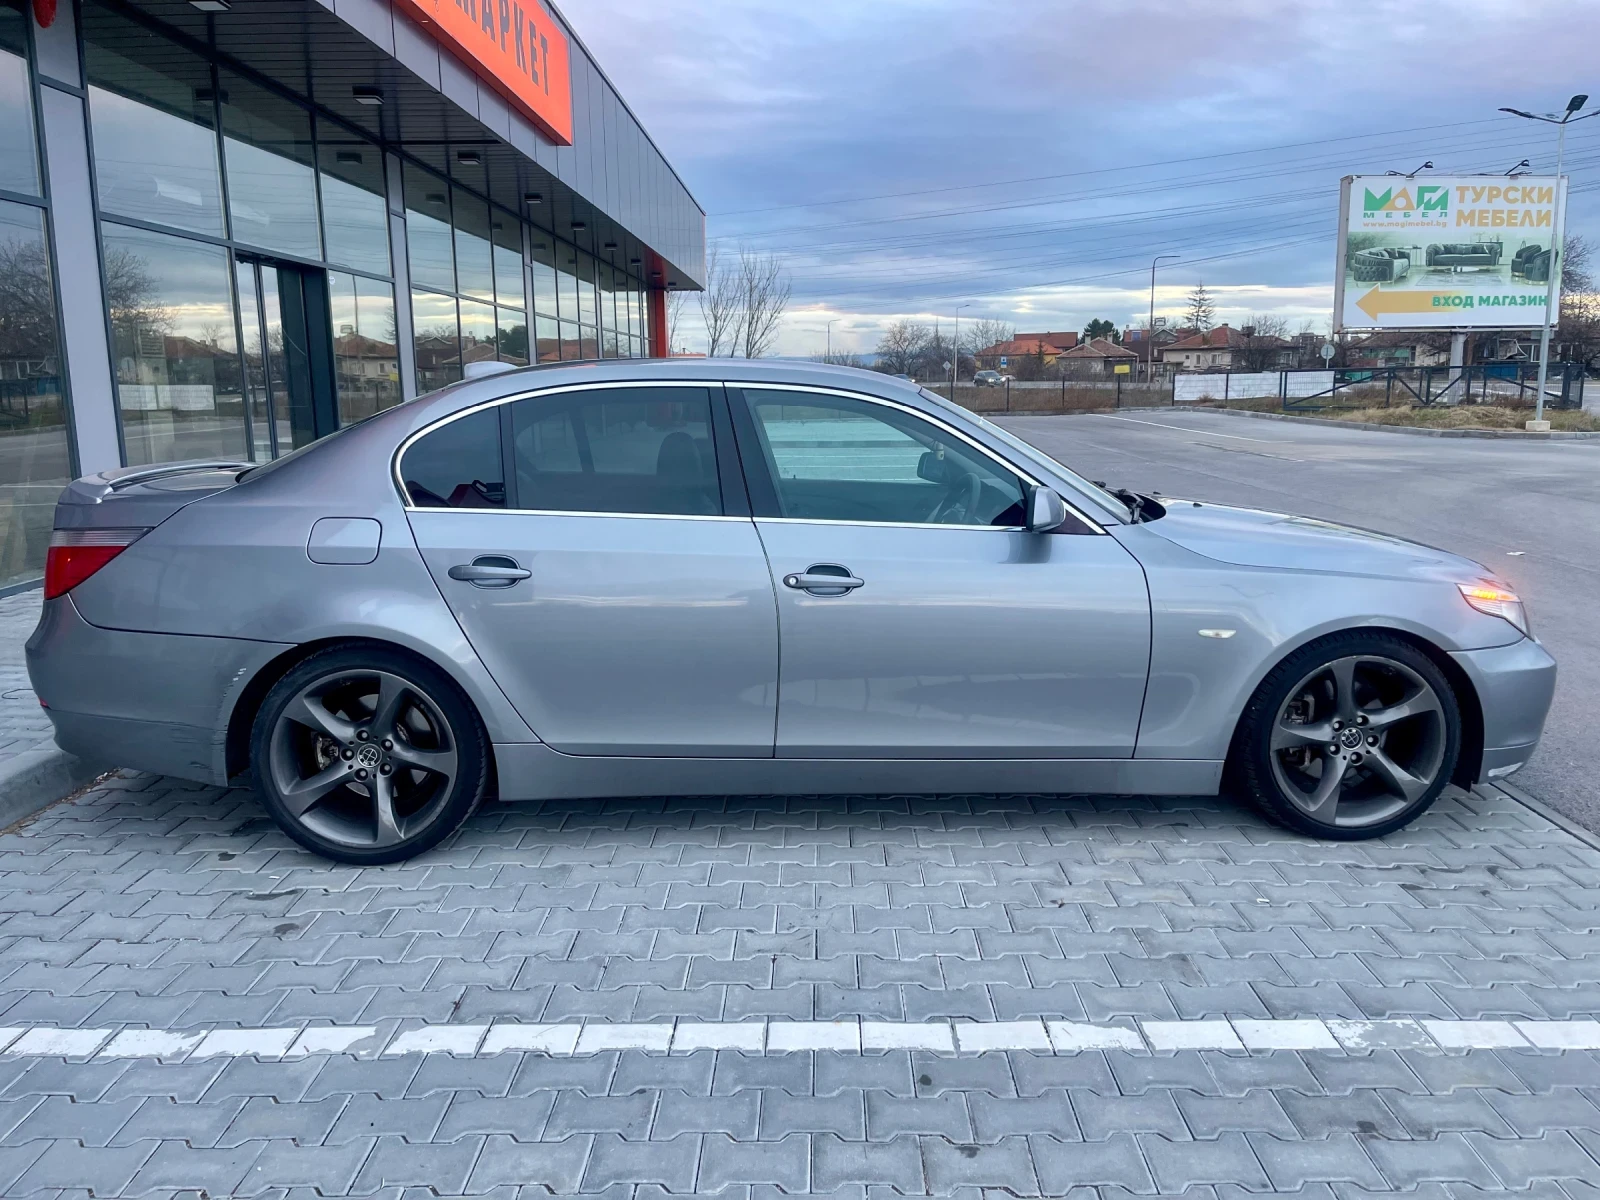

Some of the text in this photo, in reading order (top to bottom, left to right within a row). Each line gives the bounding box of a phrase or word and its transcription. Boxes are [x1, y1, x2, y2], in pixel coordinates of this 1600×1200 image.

[455, 0, 549, 96] АРКЕТ
[1364, 186, 1449, 211] МАГИ
[1456, 186, 1553, 204] ТУРСКИ
[1456, 209, 1552, 227] МЕБЕЛИ
[1432, 295, 1548, 308] ВХОД МАГАЗИН
